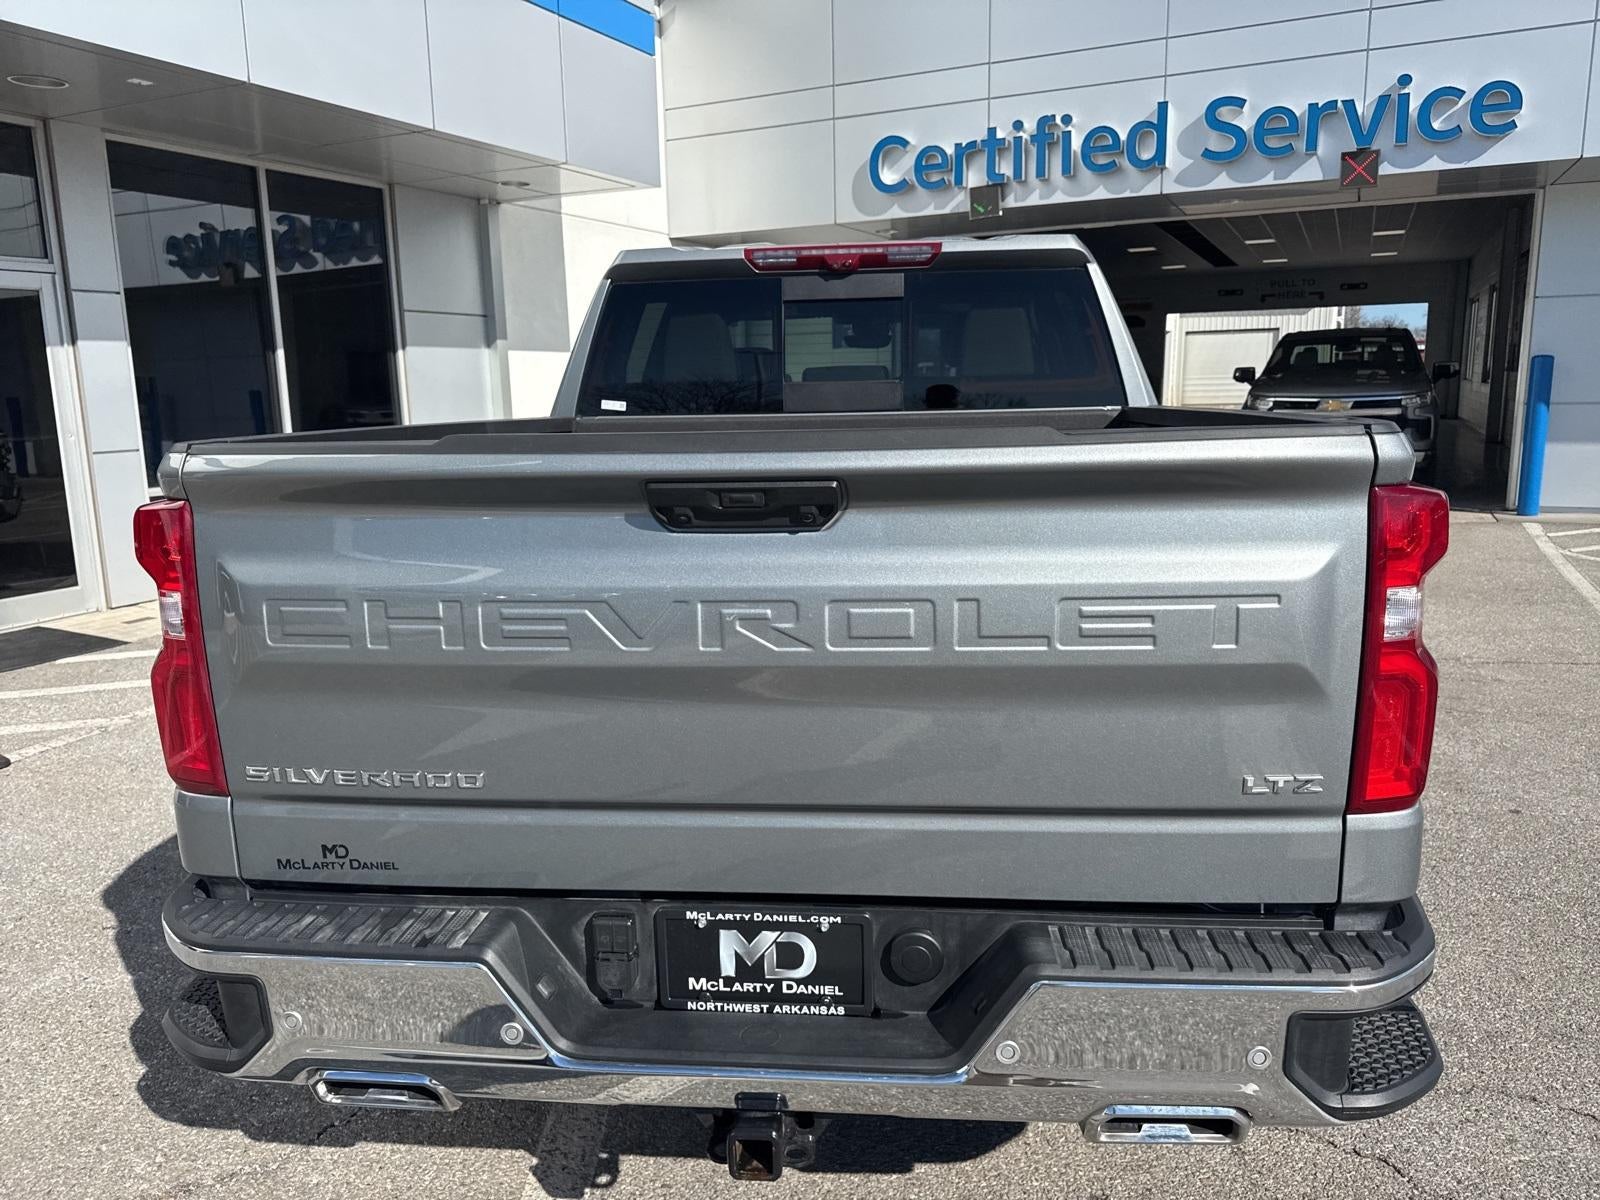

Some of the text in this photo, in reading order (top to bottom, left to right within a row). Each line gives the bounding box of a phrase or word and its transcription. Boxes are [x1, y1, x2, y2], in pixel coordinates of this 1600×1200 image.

[867, 73, 1524, 195] Certified Service
[1269, 278, 1316, 289] PULL TO
[262, 594, 1281, 652] CHEVROLET
[244, 764, 486, 789] SILVERADO
[1241, 773, 1325, 795] LTZ
[320, 844, 350, 859] MD
[348, 858, 400, 871] DANIEL
[718, 928, 818, 979] MD
[781, 980, 844, 997] DANIEL
[687, 1001, 846, 1016] NORTHWEST ARKANSAS
